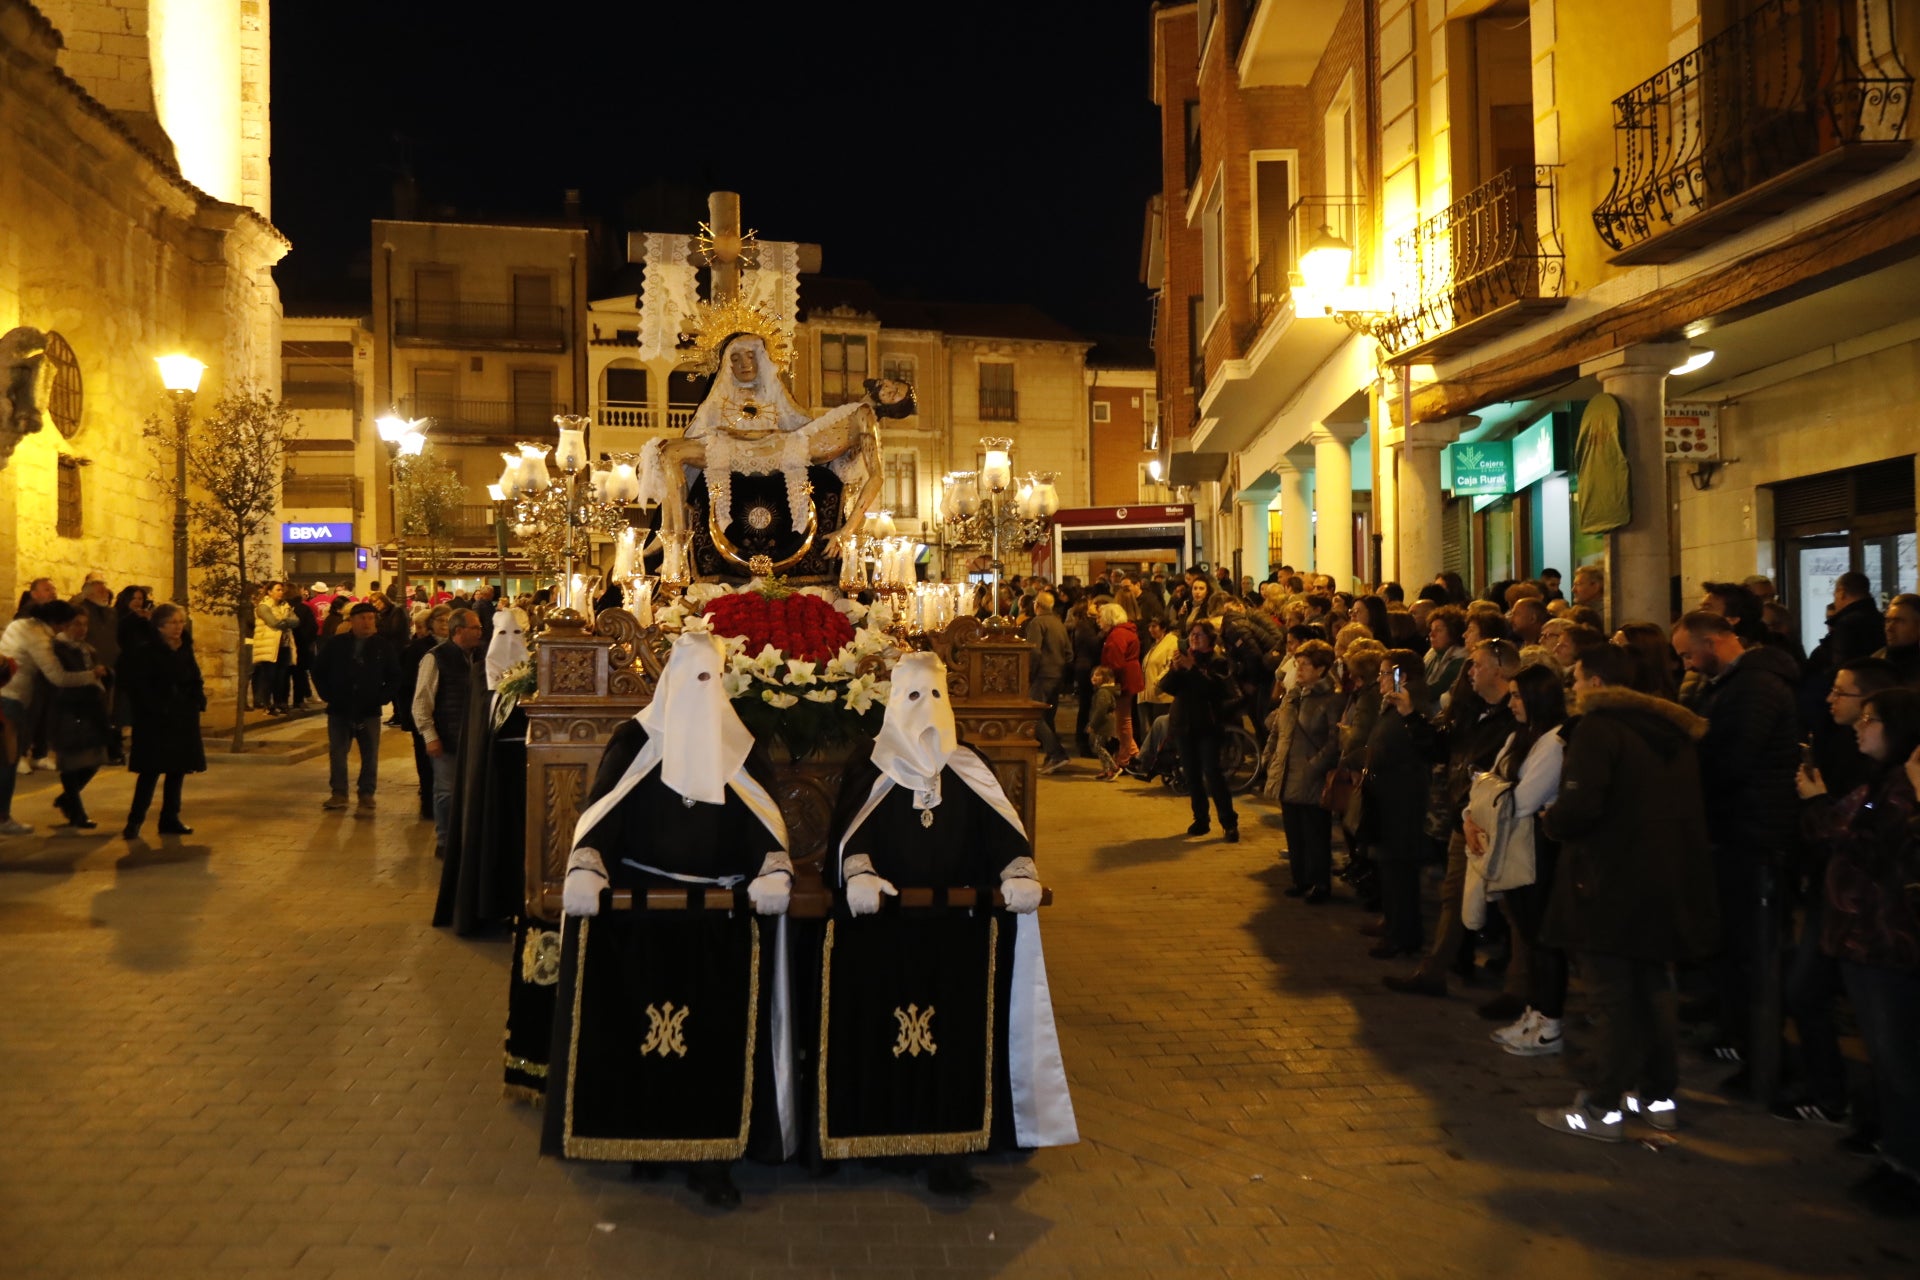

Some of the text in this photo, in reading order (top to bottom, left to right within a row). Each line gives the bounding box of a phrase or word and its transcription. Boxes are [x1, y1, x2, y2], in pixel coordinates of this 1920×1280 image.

[1480, 460, 1504, 468] Cajero
[1457, 474, 1506, 486] Caja Rural
[289, 525, 332, 539] BBVA
